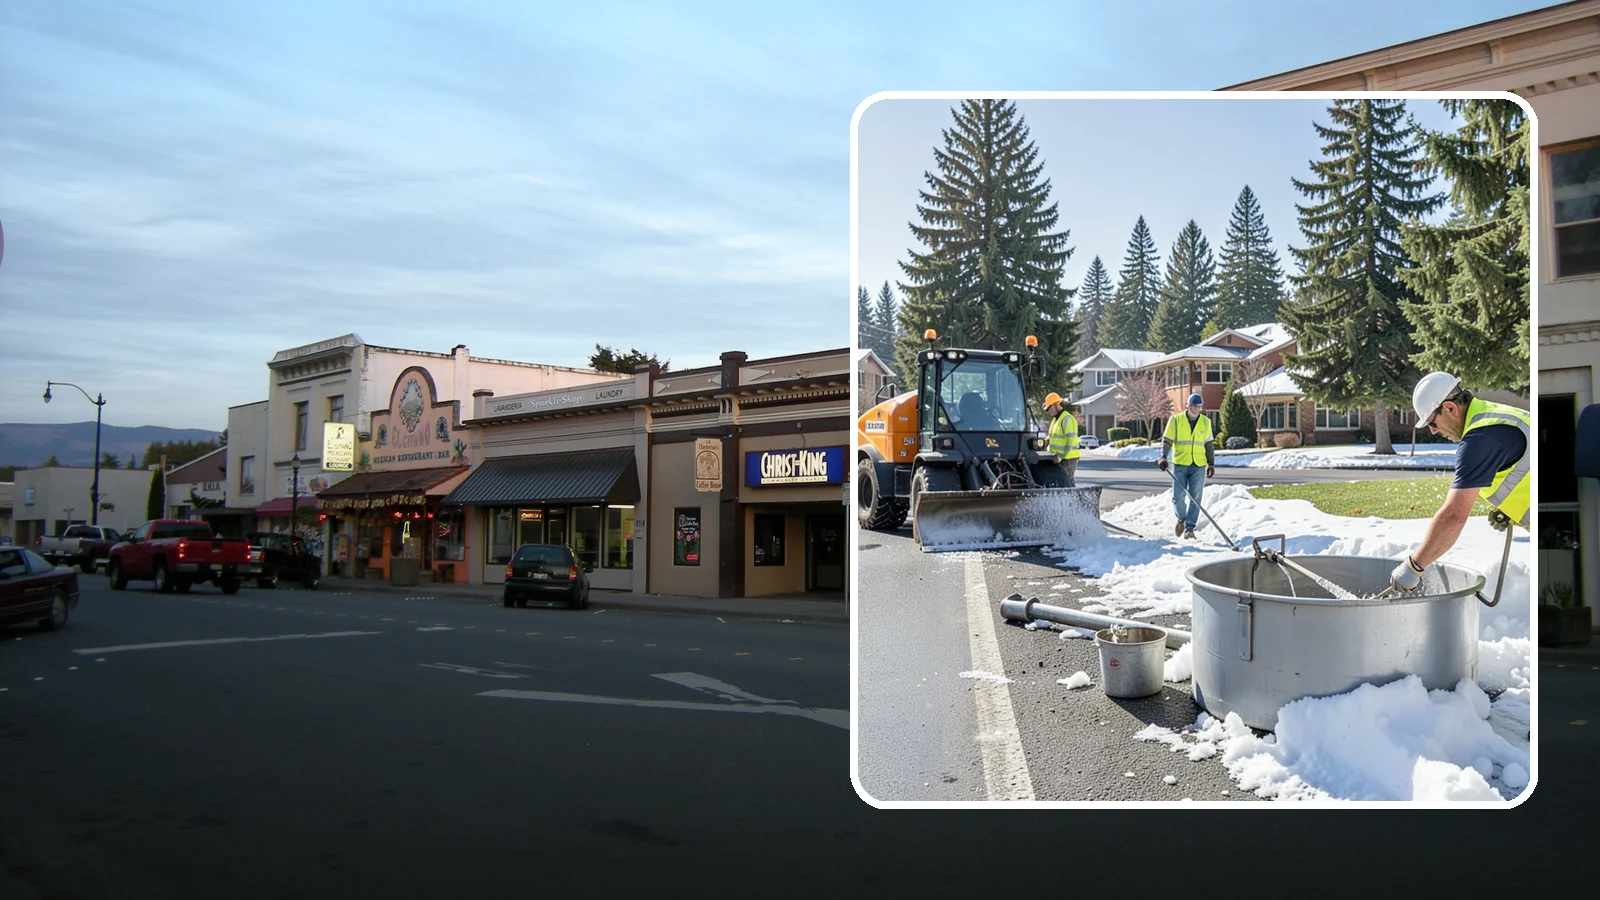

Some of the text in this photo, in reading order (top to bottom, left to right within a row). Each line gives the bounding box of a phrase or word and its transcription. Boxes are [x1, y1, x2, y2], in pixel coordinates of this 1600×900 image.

[493, 389, 624, 412] LAVANDERIA Sparkle Shop LAUNDRY
[374, 454, 396, 464] MEXICAN
[397, 451, 433, 462] RESTAURANT
[438, 450, 450, 459] BAR
[761, 452, 797, 478] CHRIST
[799, 450, 828, 476] KING
